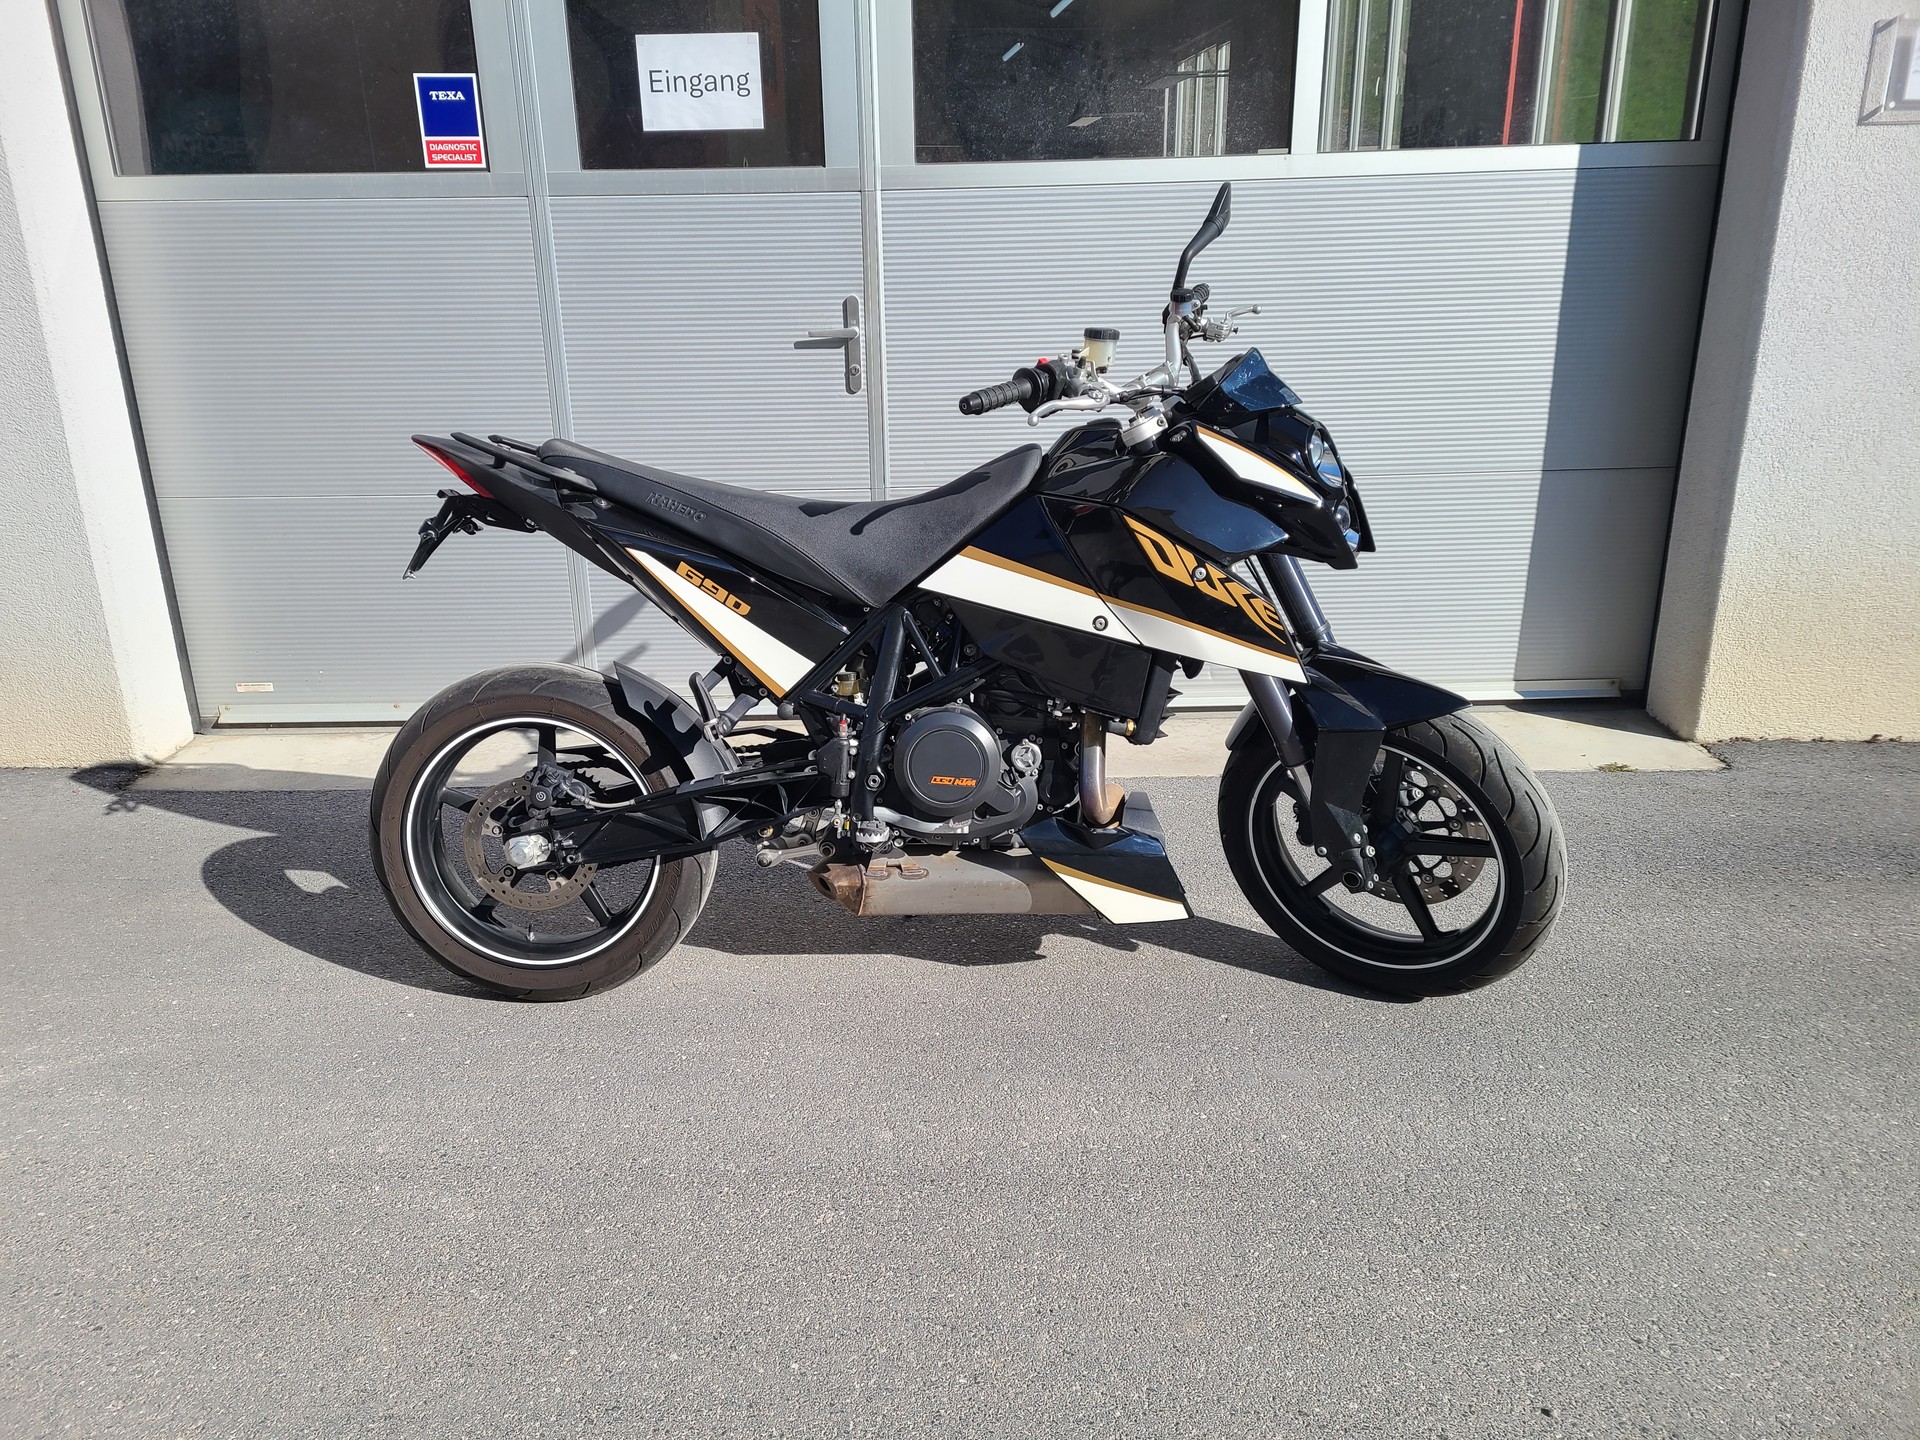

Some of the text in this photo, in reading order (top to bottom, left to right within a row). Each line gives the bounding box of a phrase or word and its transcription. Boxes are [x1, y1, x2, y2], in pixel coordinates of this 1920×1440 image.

[648, 69, 751, 98] Eingang
[429, 90, 465, 100] TEXA
[429, 143, 478, 151] DIAGNOSTIC
[431, 153, 478, 161] SPECIALIST
[675, 560, 752, 616] 690
[1122, 514, 1287, 645] DUKE
